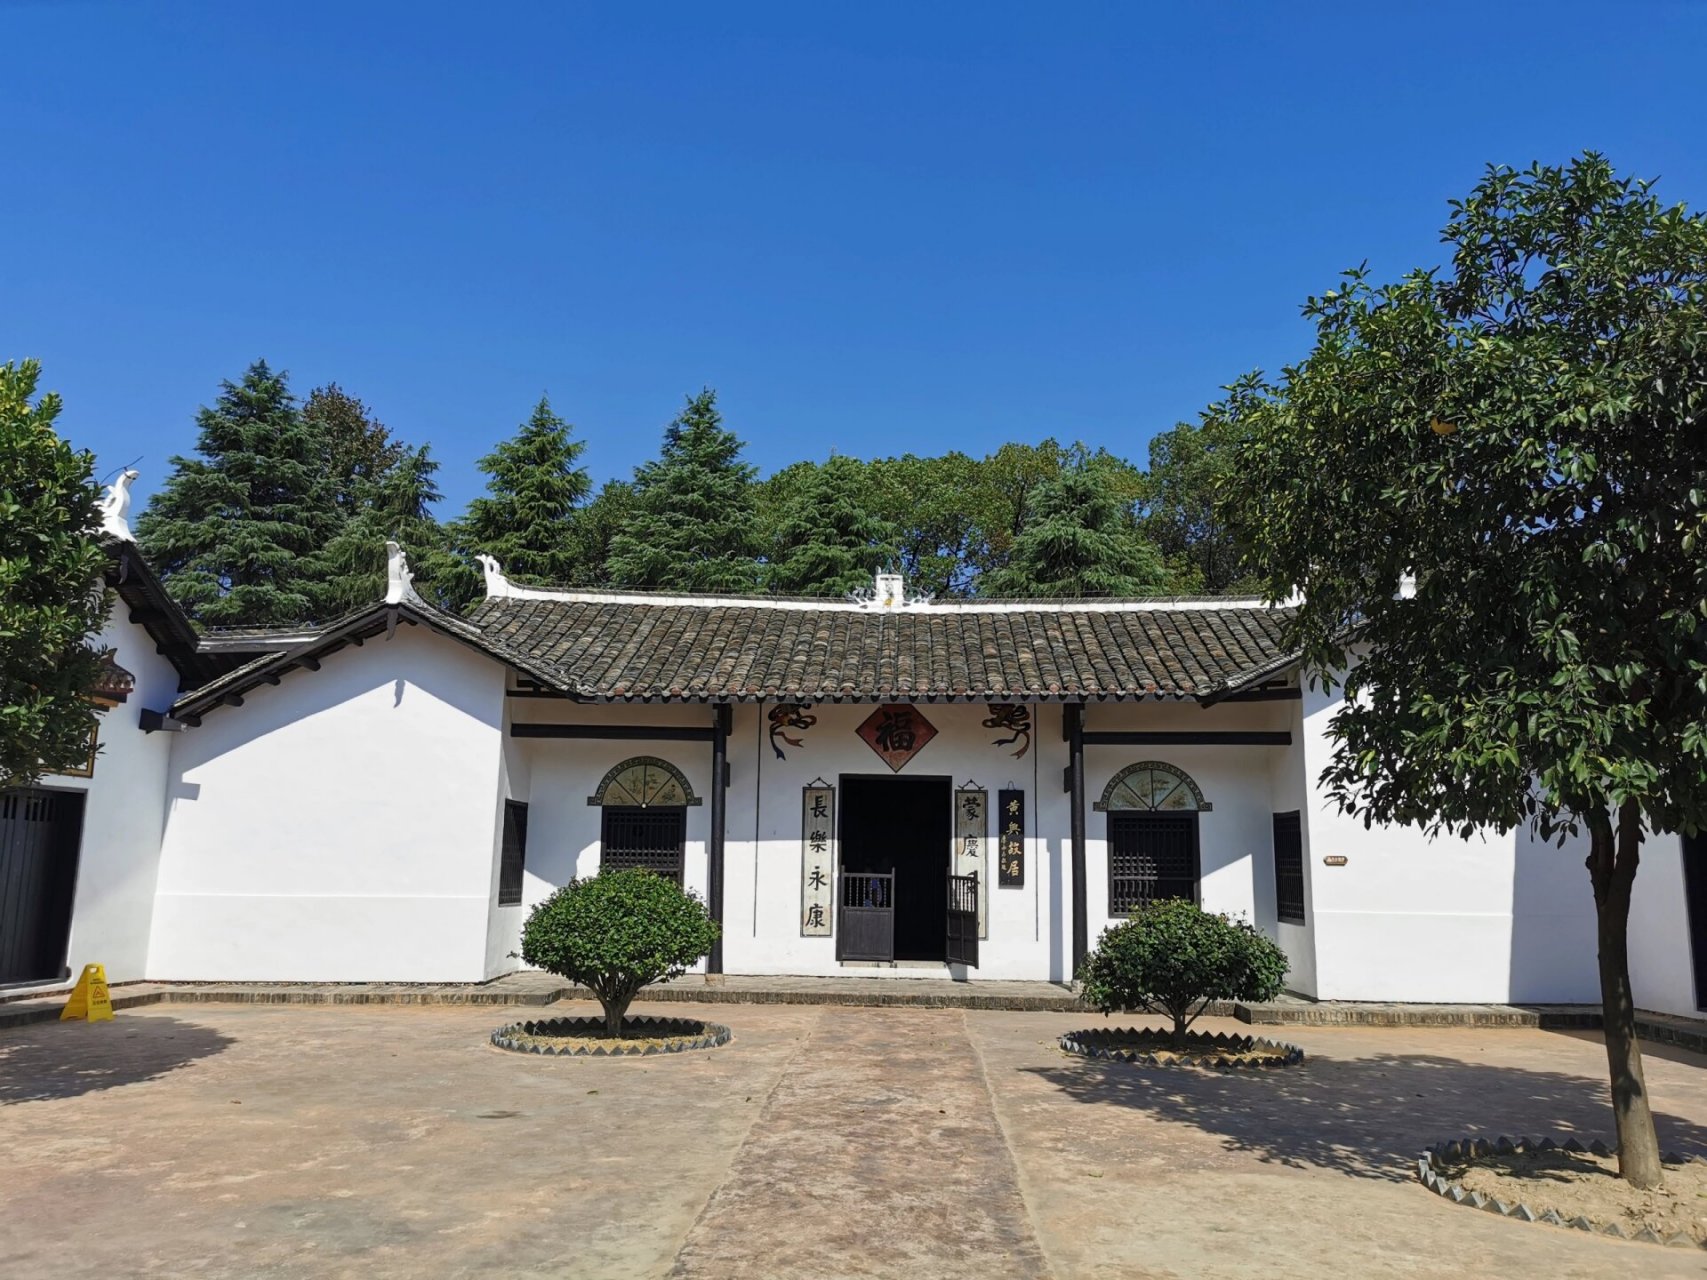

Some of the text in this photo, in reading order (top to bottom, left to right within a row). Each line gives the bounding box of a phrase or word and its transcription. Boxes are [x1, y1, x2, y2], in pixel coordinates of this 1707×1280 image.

[875, 710, 916, 752] 福
[805, 795, 829, 928] 長樂永康
